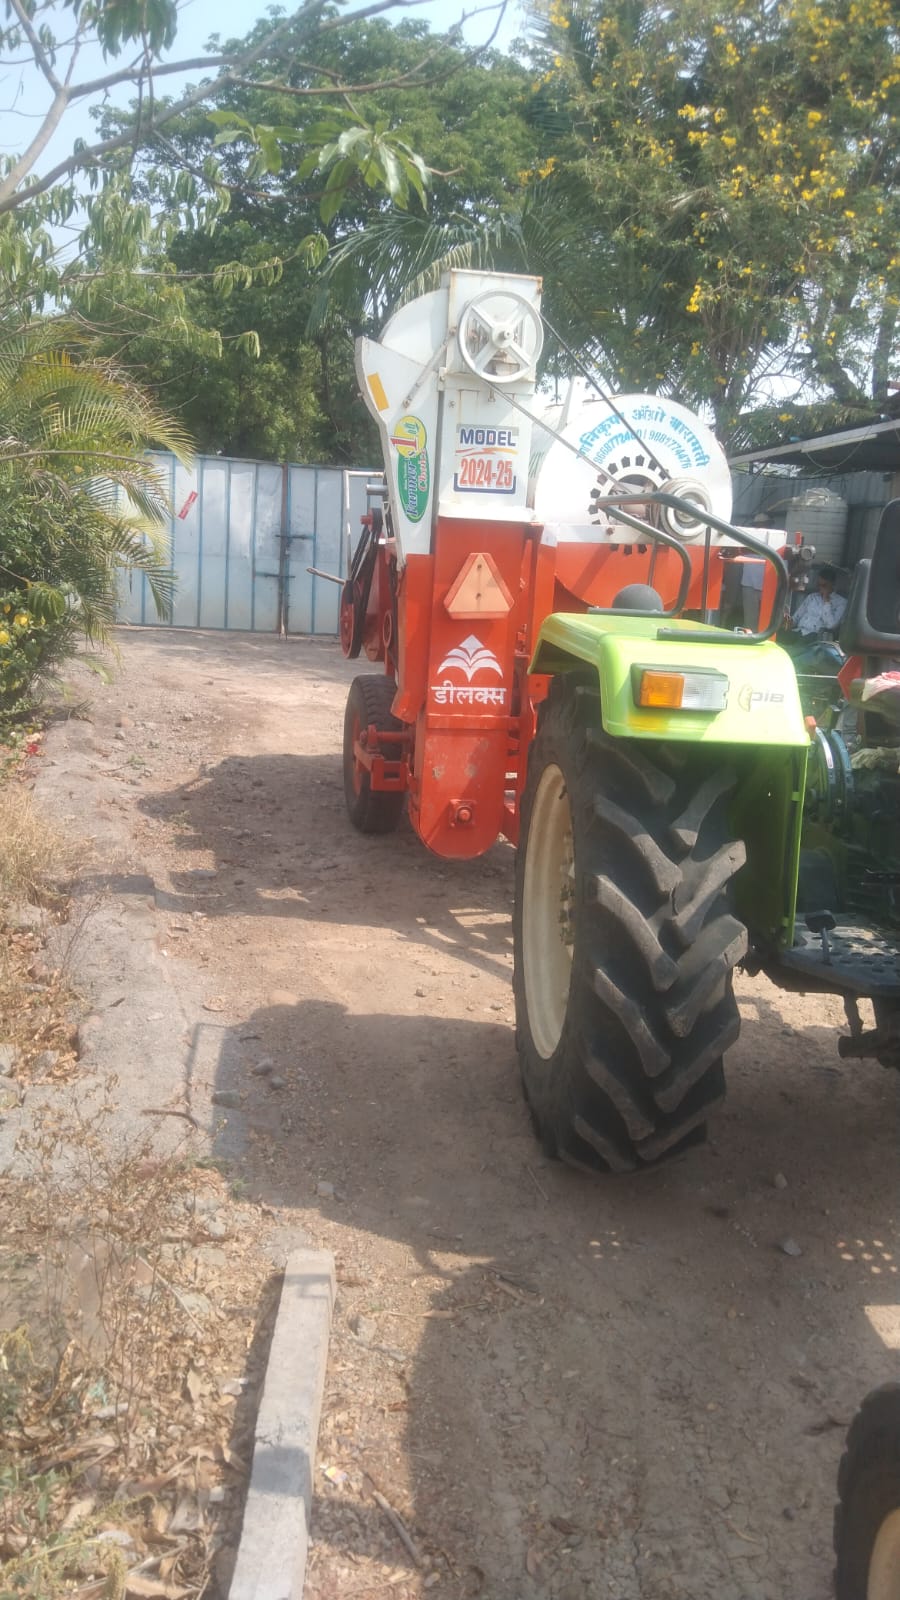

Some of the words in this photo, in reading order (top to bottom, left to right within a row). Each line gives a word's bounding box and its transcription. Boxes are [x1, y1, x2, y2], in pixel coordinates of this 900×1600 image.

[460, 428, 516, 447] MODEL
[459, 458, 513, 487] 2024-25
[431, 679, 507, 705] डीलक्स
